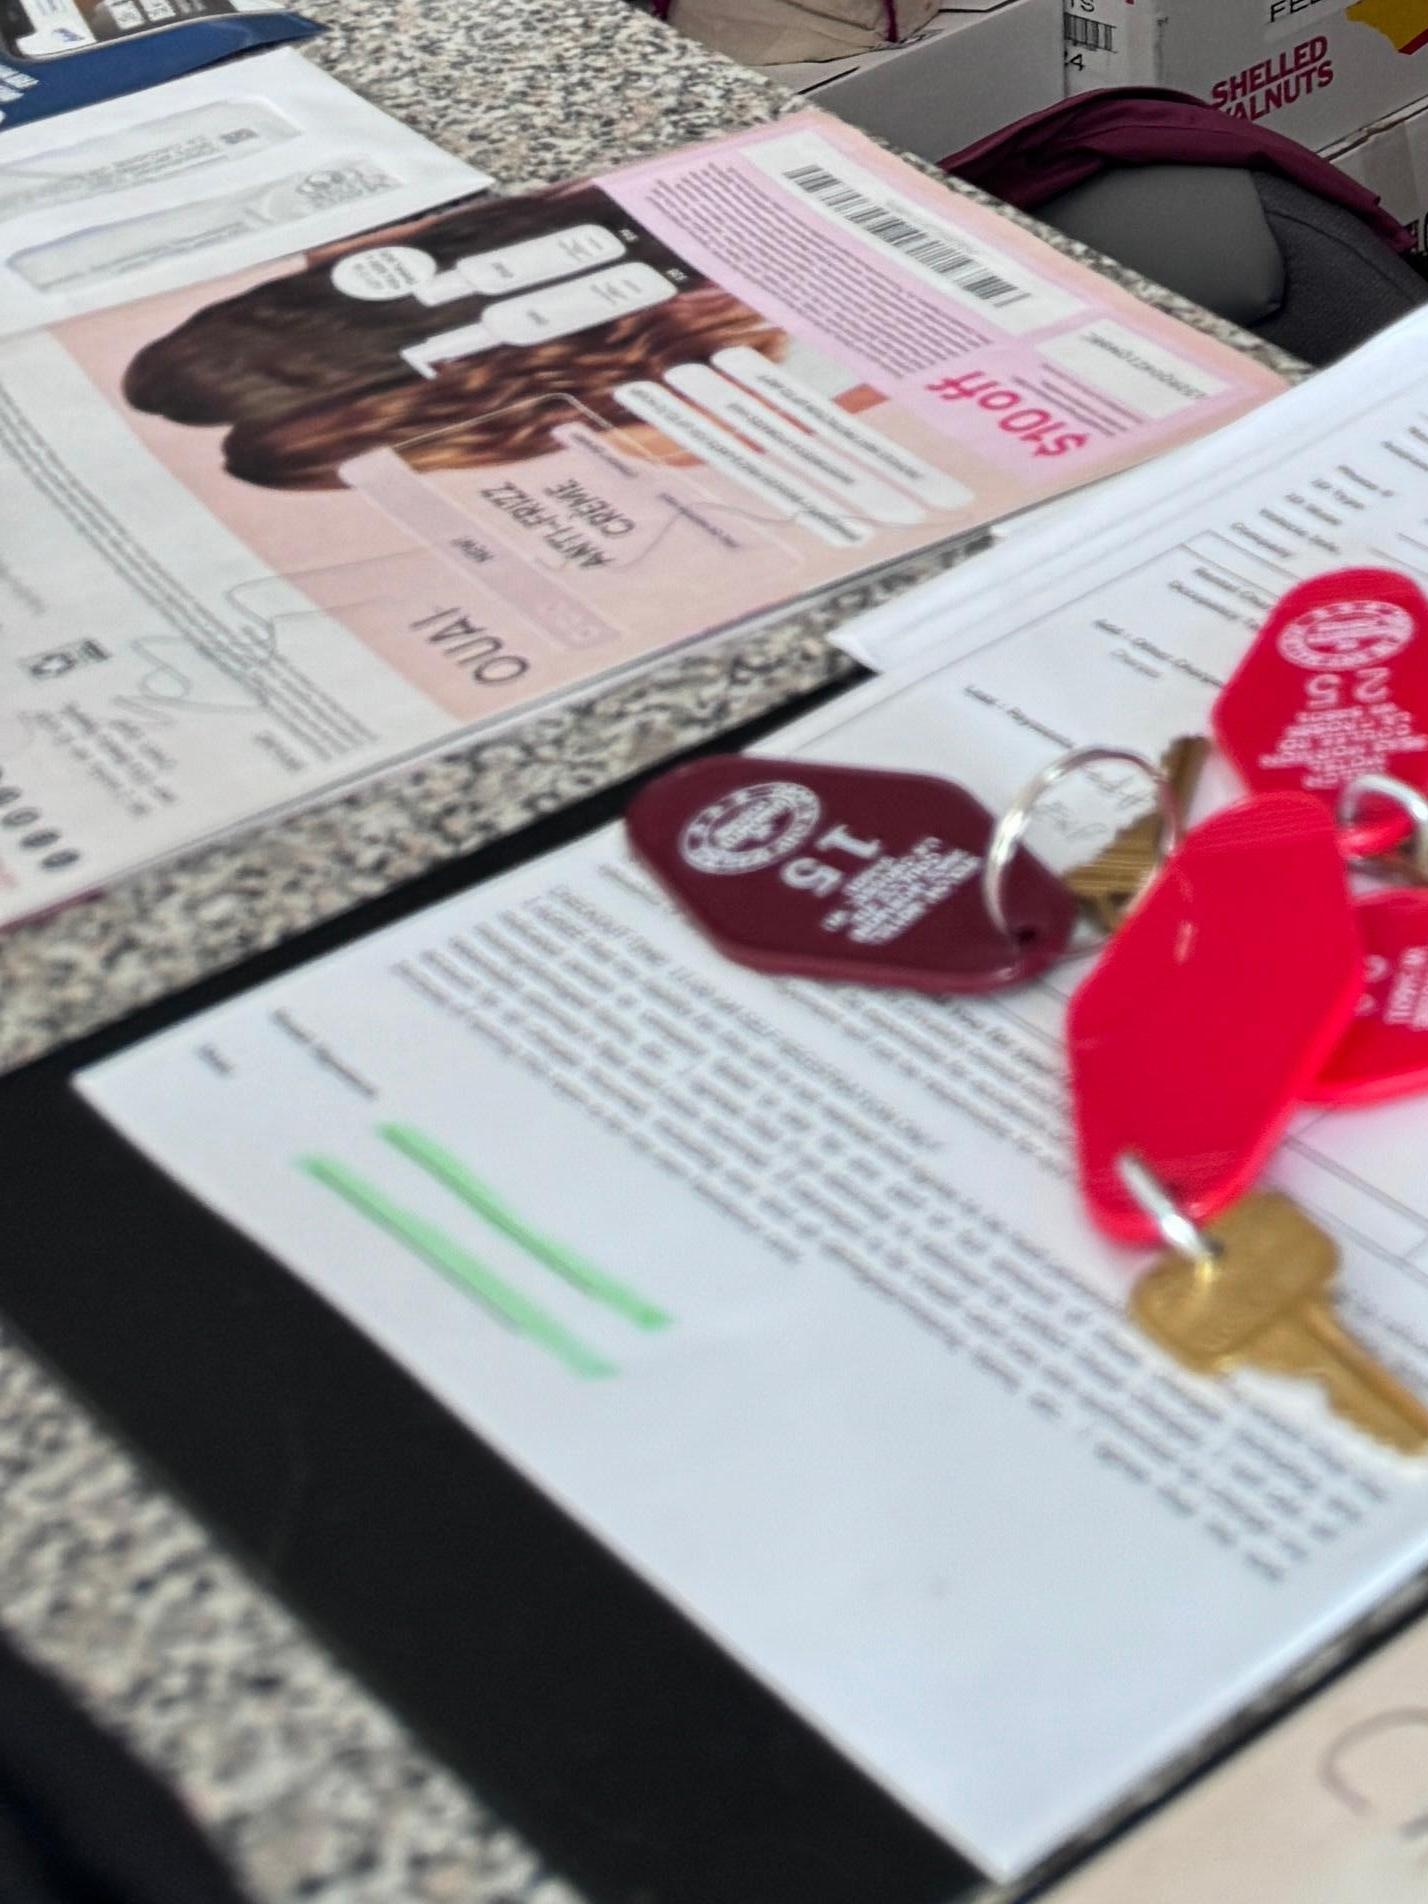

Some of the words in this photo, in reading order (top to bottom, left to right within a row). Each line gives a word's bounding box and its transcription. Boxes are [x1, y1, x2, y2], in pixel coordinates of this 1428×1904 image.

[1210, 35, 1329, 107] SHELLED
[923, 369, 1023, 412] off
[998, 407, 1091, 459] $10
[479, 480, 616, 570] ANTI-FRIZZ
[409, 605, 531, 686] OUAI
[1306, 666, 1390, 709] 25
[779, 821, 881, 900] 15
